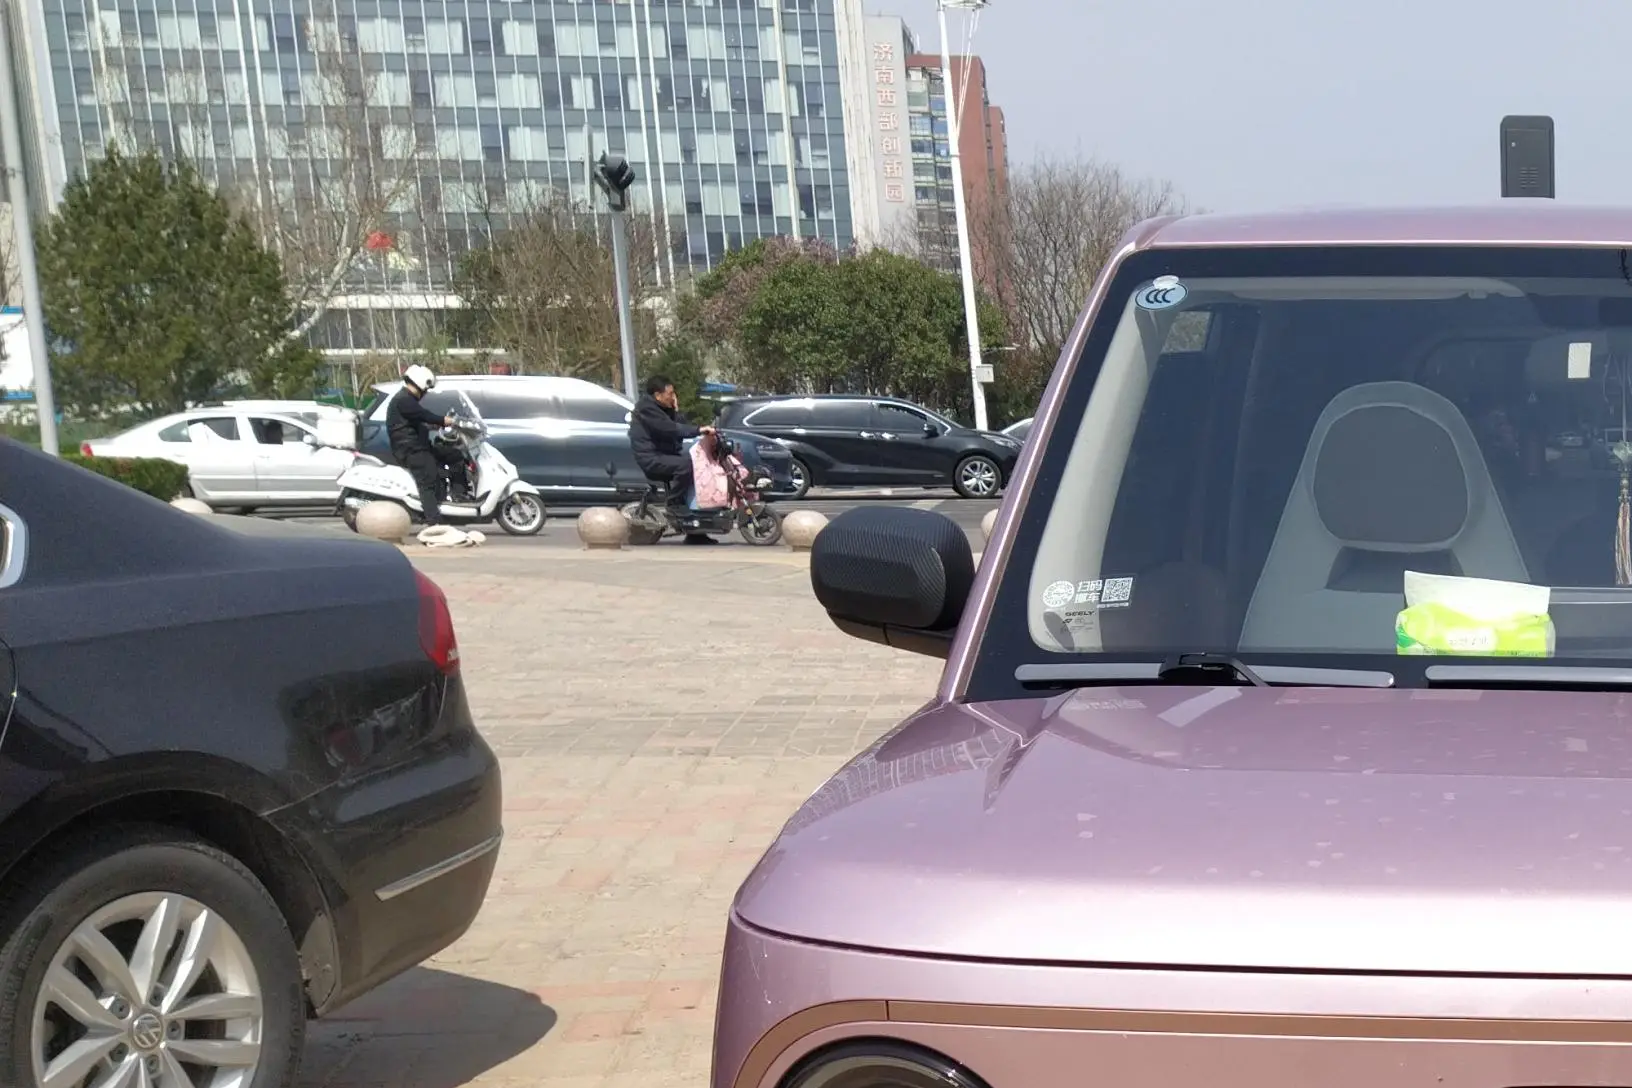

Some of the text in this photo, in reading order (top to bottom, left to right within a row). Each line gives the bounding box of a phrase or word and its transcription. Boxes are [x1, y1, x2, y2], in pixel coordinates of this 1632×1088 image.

[873, 42, 905, 203] 济南西部创新园
